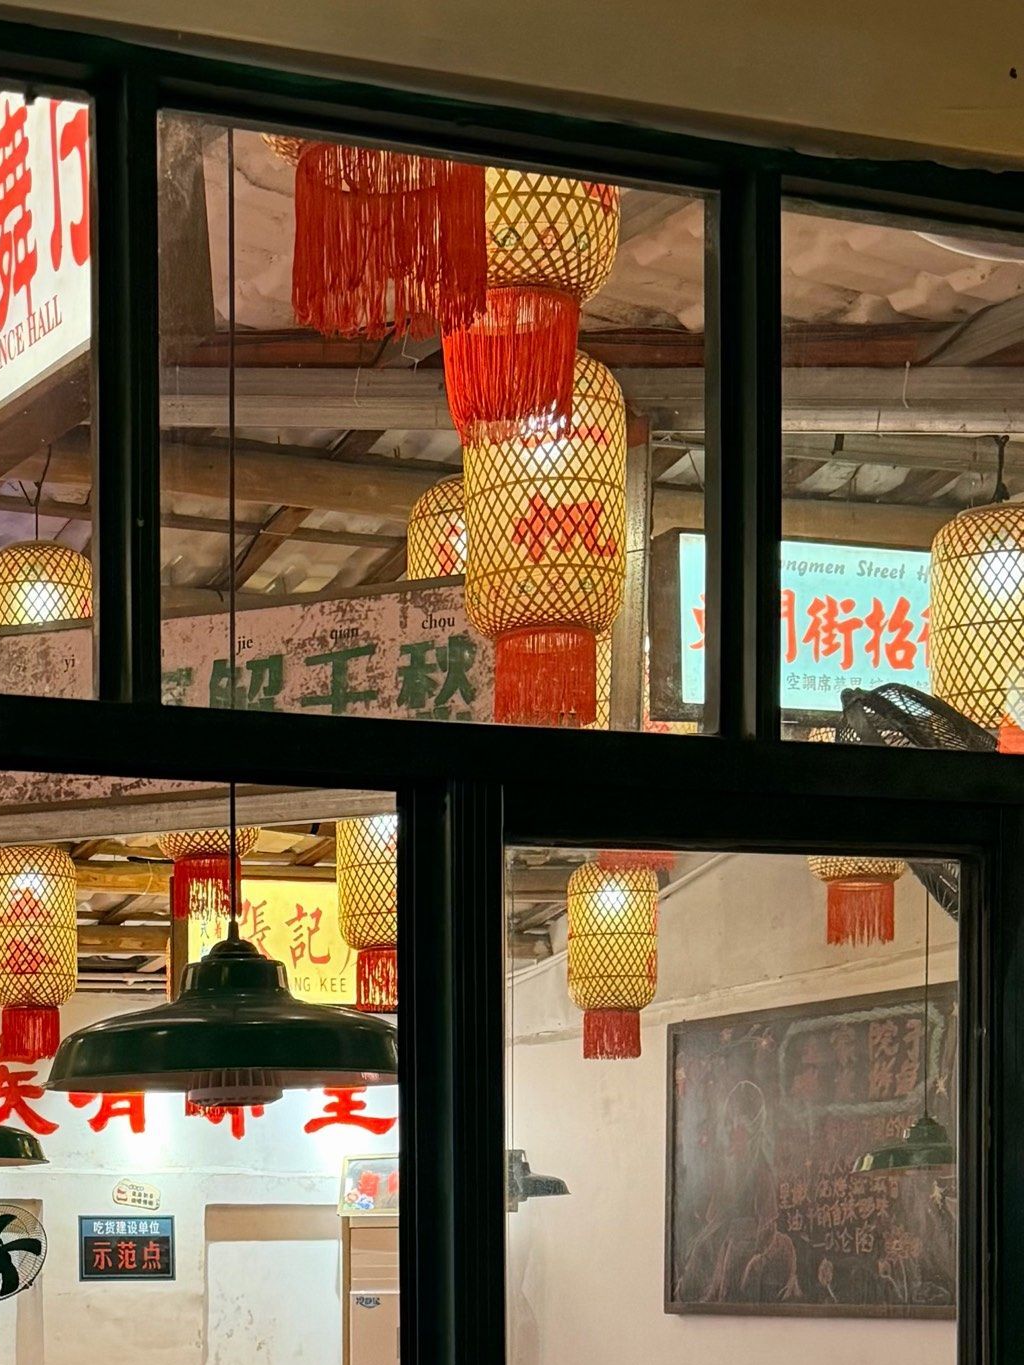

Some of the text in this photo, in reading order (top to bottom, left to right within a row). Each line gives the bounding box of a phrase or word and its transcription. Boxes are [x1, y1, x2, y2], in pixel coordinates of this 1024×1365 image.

[27, 293, 64, 350] HALL
[781, 559, 845, 577] ngmen
[856, 559, 906, 580] Street
[236, 636, 254, 655] jie
[329, 626, 360, 643] qian
[421, 613, 456, 632] chou
[319, 976, 348, 994] KEE
[93, 1219, 161, 1235] 吃货建设单位
[92, 1240, 162, 1271] 示范点
